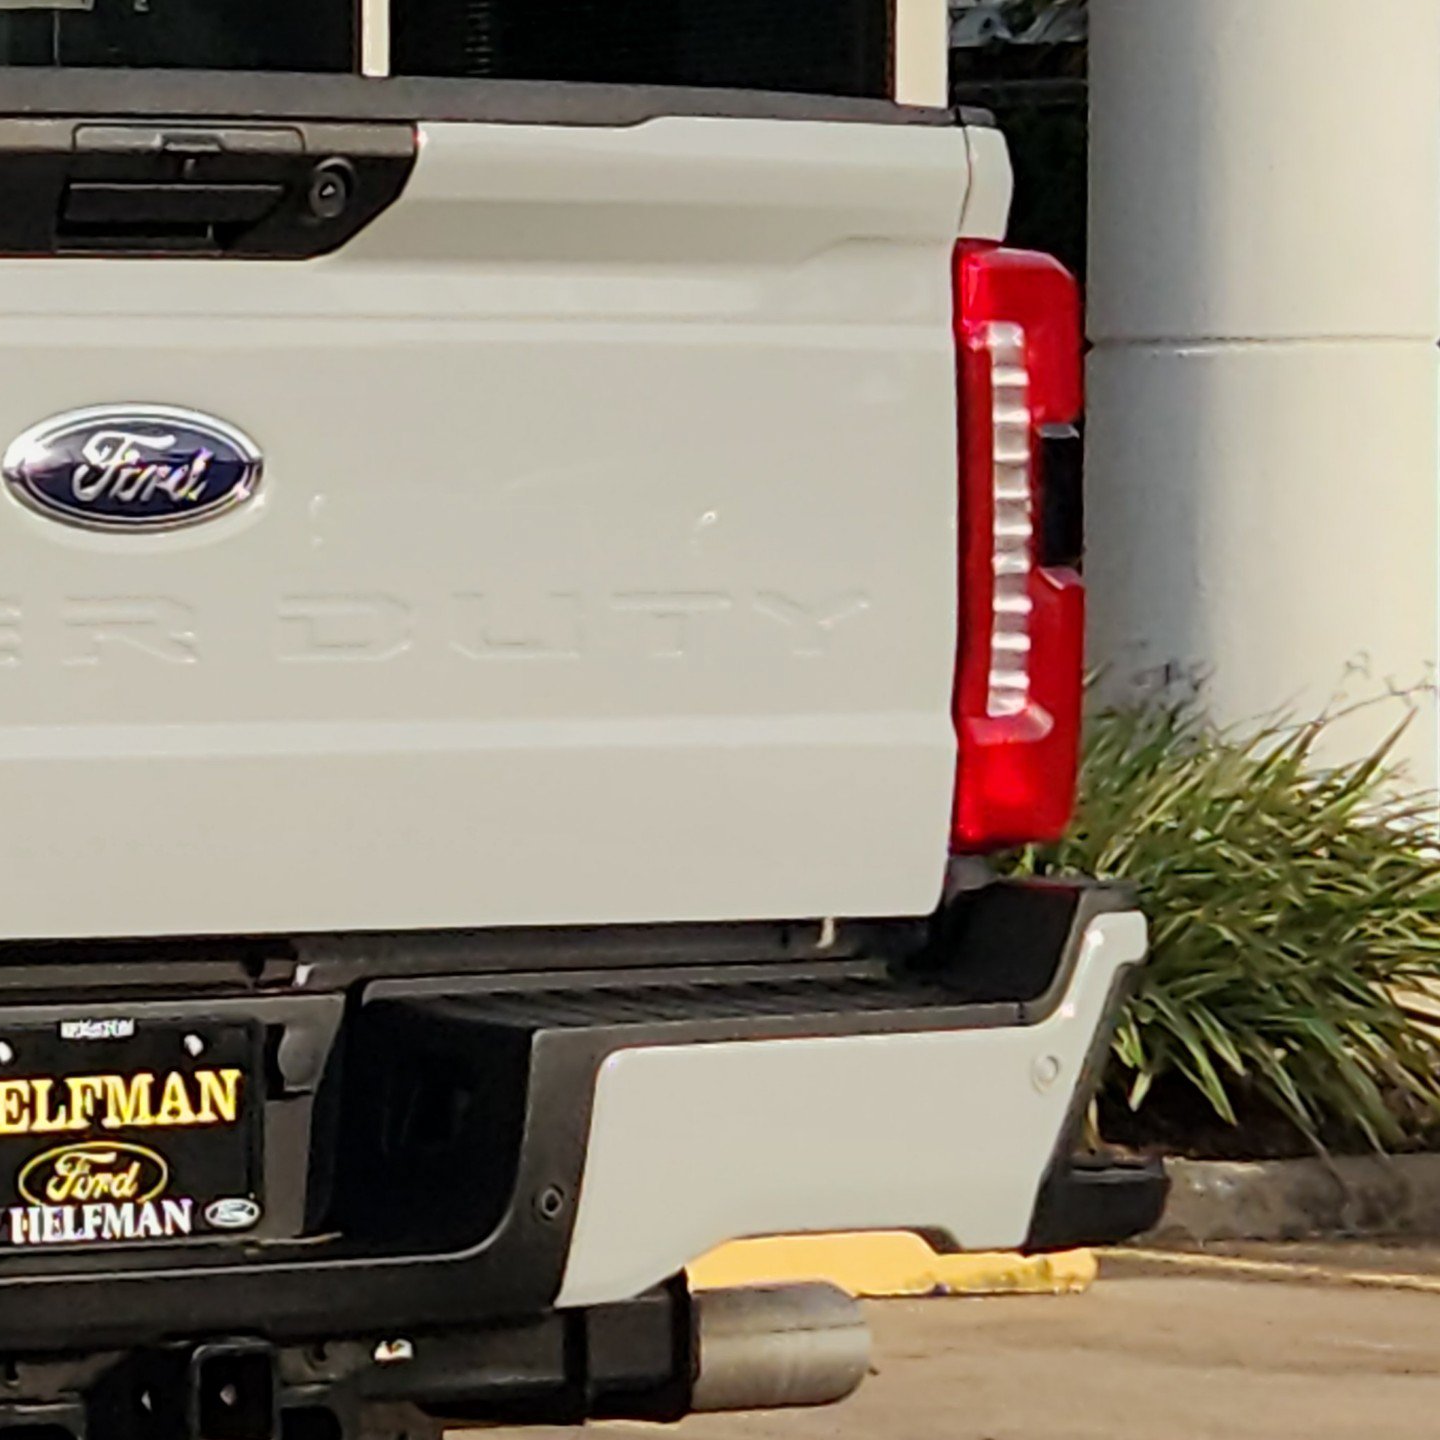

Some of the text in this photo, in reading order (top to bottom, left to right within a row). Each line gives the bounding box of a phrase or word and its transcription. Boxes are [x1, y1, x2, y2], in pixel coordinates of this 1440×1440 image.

[72, 430, 215, 503] Ford
[276, 587, 873, 664] DUTY
[45, 1149, 143, 1201] Ford
[8, 1198, 194, 1246] HELFMAN
